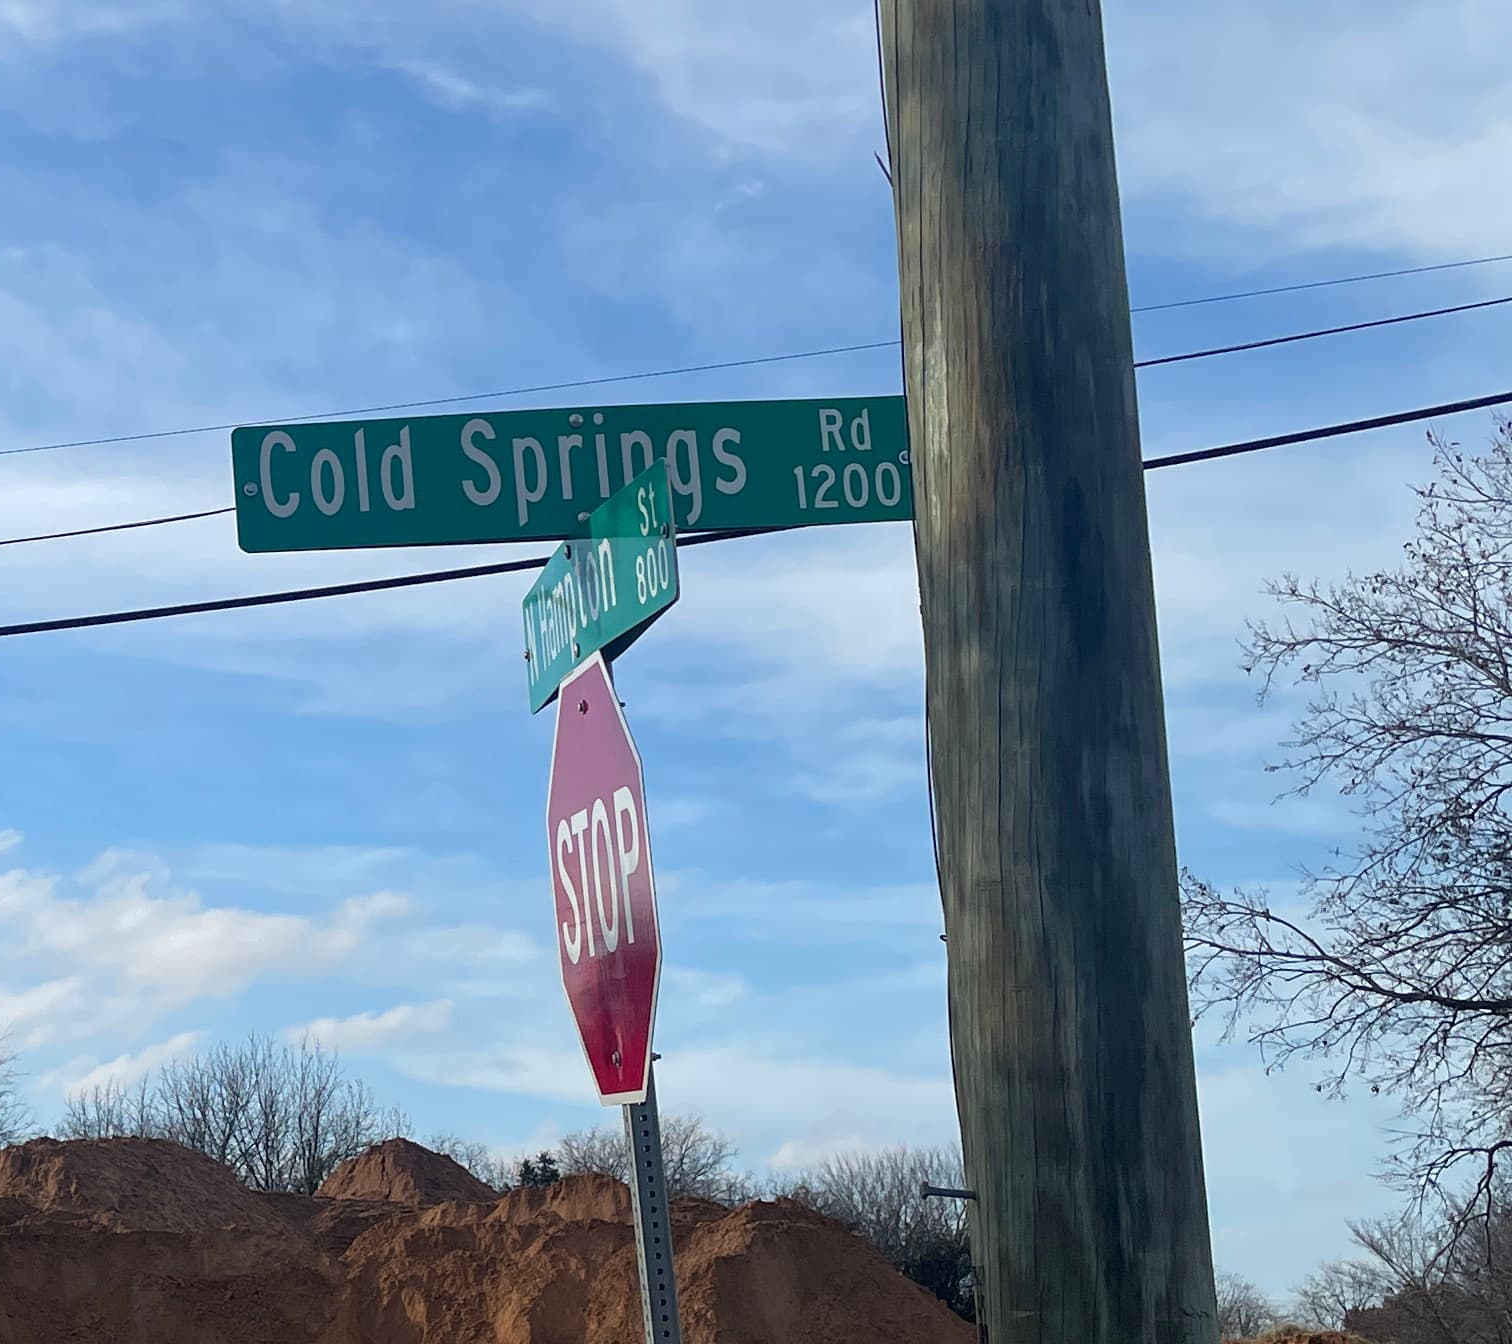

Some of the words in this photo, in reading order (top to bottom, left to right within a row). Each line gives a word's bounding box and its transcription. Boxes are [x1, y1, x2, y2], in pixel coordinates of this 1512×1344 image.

[819, 408, 871, 452] Rd
[259, 425, 415, 518] Cold
[460, 412, 747, 527] Springs
[793, 462, 902, 510] 1200
[638, 481, 658, 536] St
[636, 539, 669, 605] 800
[526, 602, 539, 685] N
[540, 538, 617, 672] Hampton
[557, 786, 639, 965] STOP
